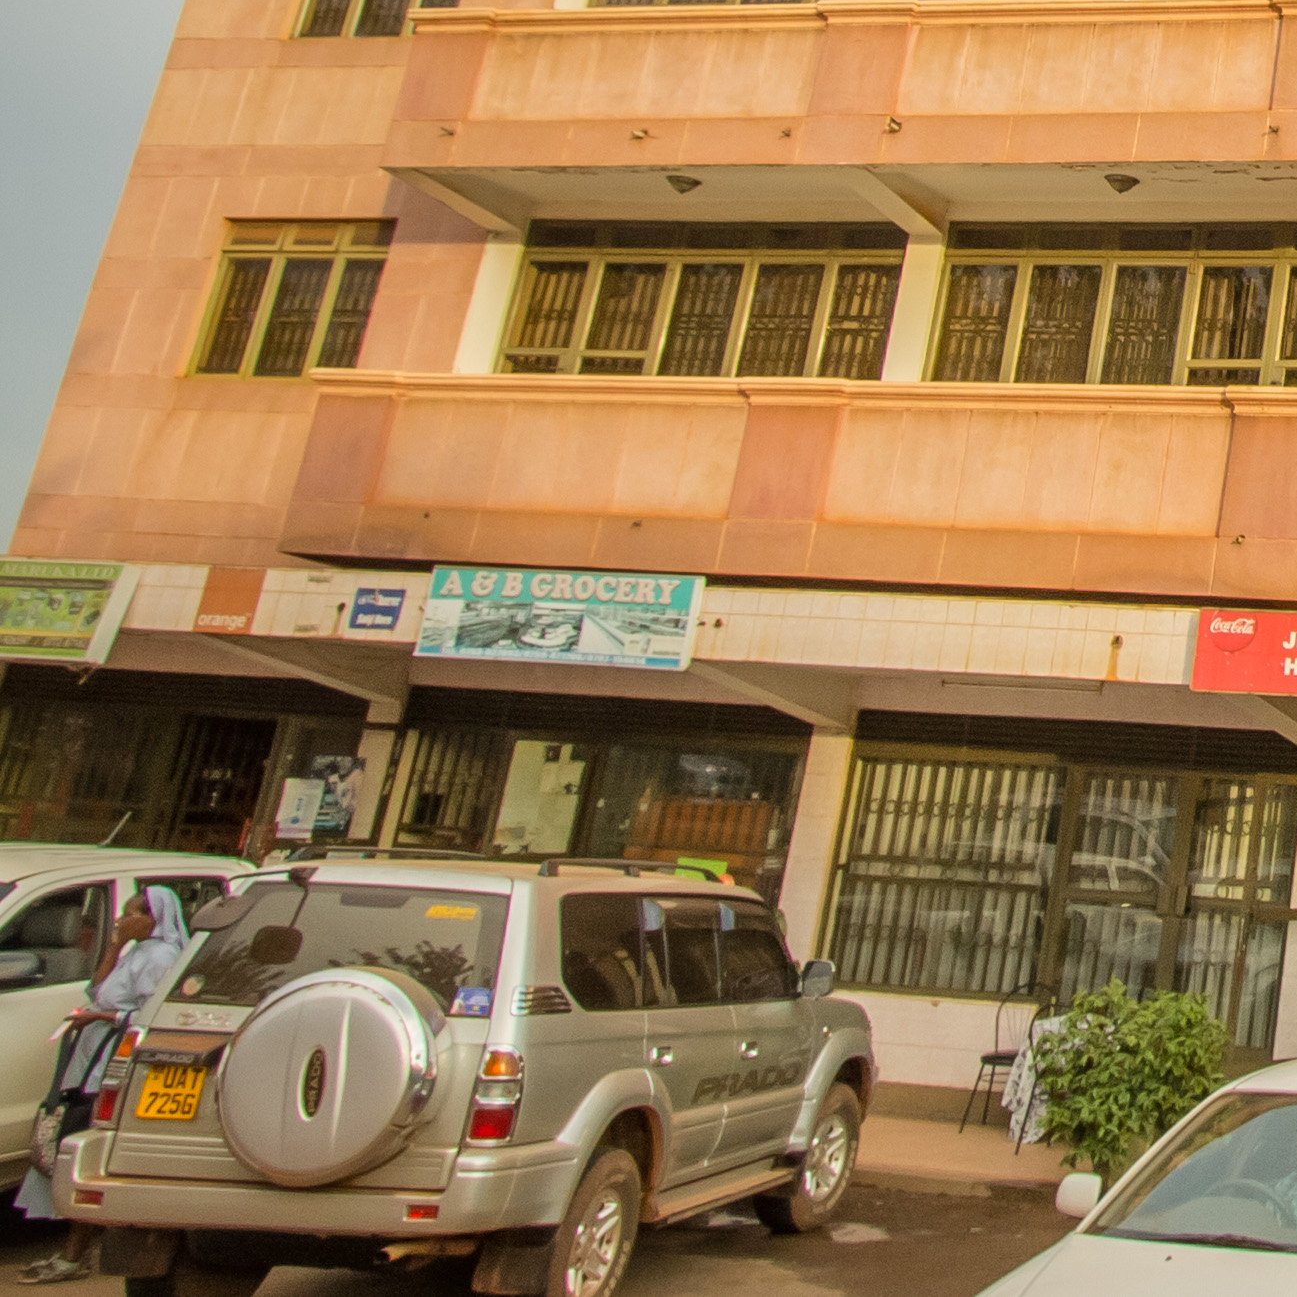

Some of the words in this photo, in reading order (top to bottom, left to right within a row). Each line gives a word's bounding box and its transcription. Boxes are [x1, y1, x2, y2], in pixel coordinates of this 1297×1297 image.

[438, 570, 464, 597] A
[470, 570, 499, 598] &
[500, 571, 524, 599] B
[529, 573, 681, 606] GROCERY
[197, 613, 247, 630] orange
[1209, 616, 1255, 635] Coca-Cola
[162, 1067, 204, 1090] UAT
[144, 1091, 196, 1115] 725G
